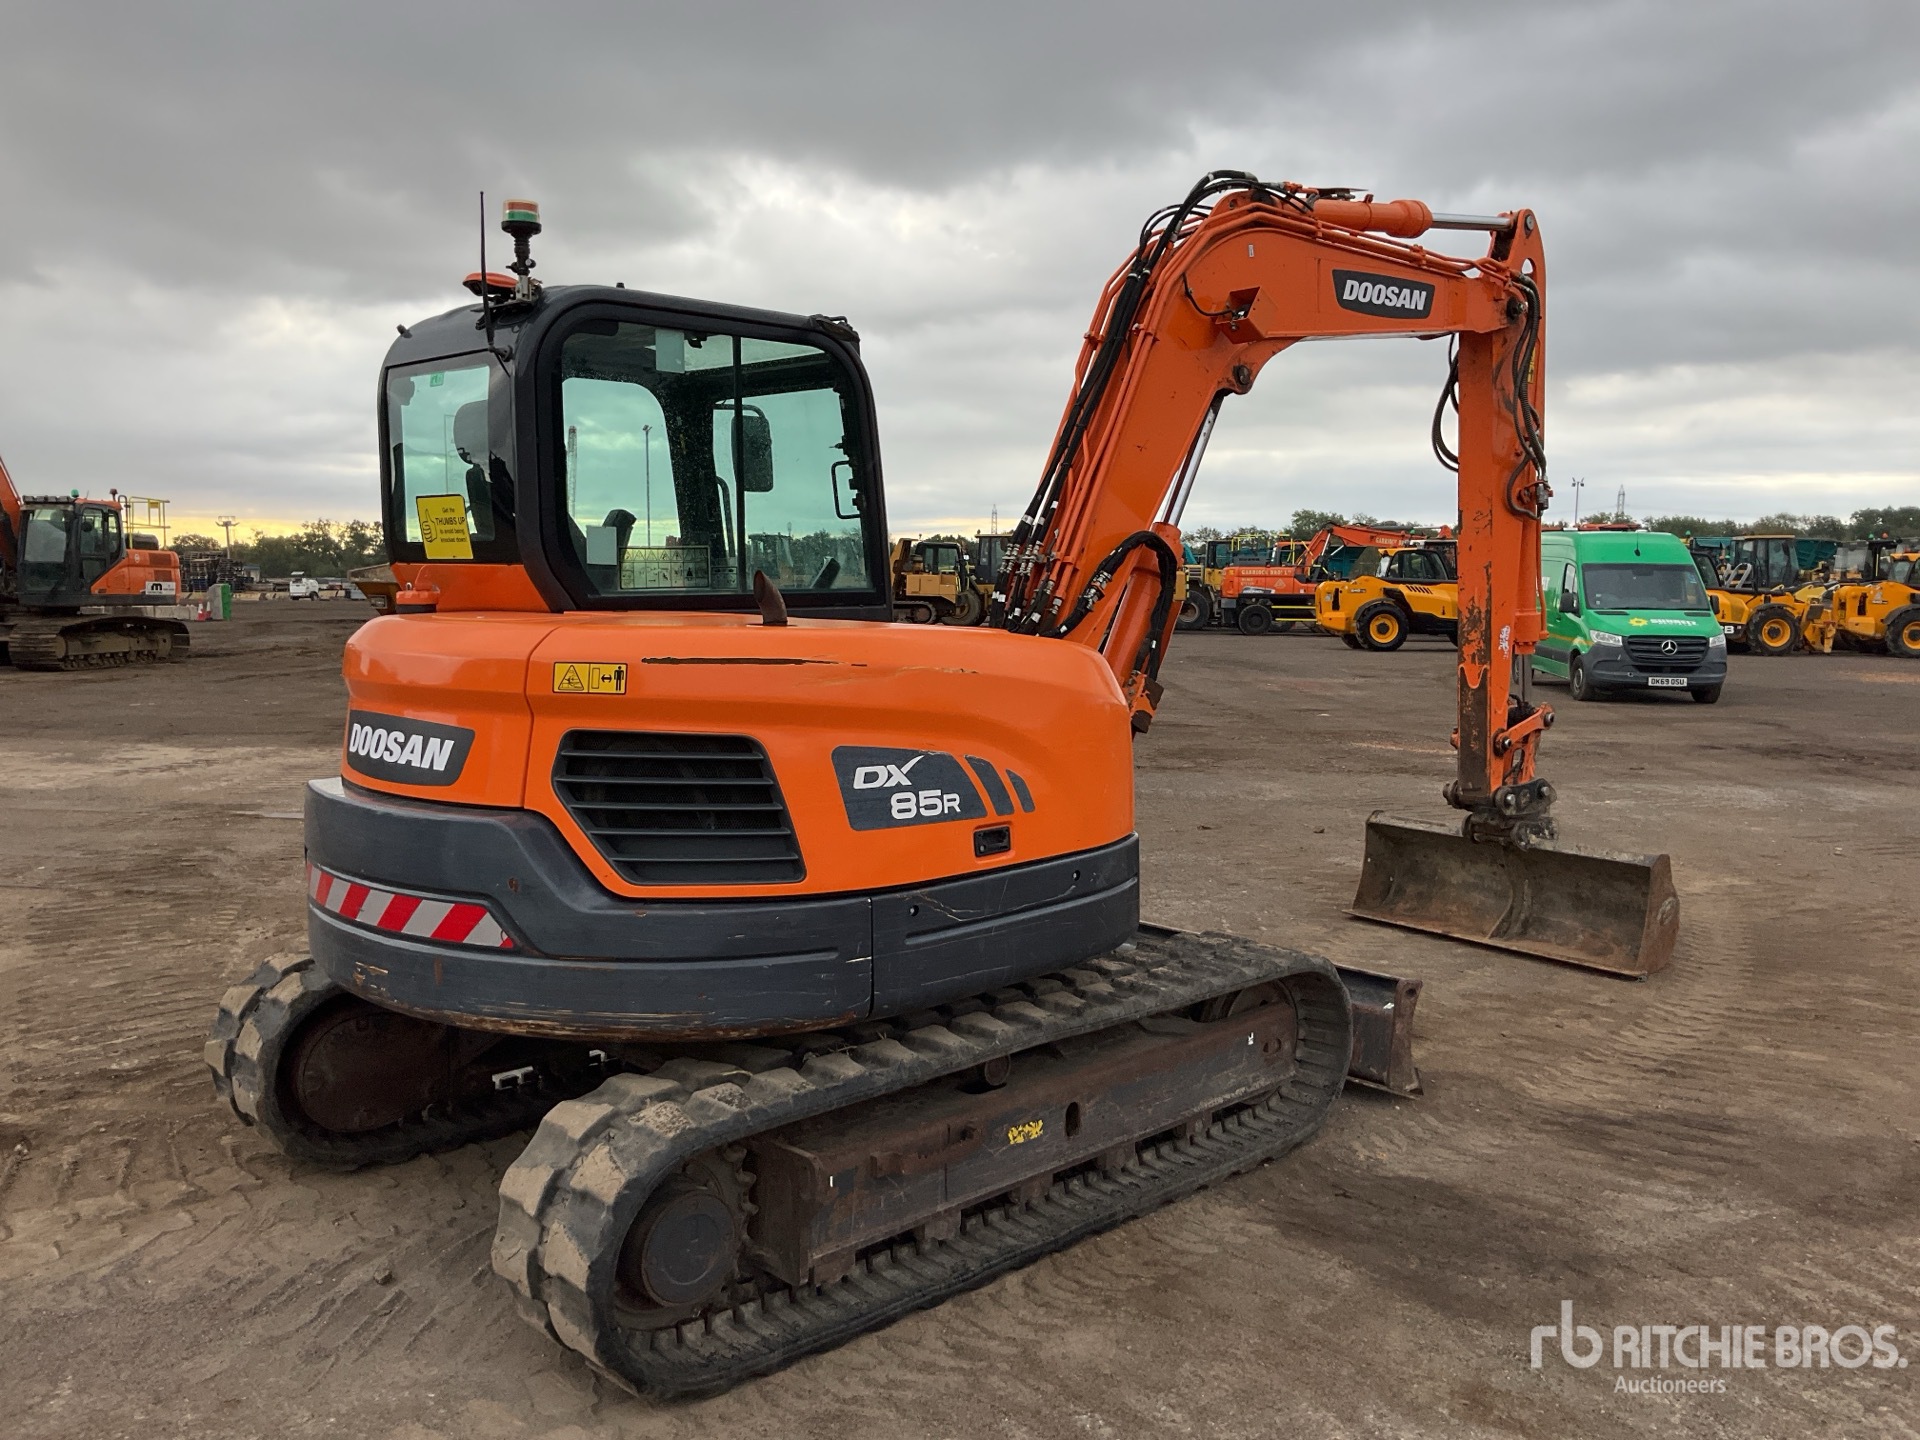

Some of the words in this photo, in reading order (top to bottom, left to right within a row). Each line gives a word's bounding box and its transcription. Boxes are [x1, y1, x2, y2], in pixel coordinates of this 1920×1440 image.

[1343, 280, 1426, 311] DOOSAN
[435, 517, 457, 526] THUMBS
[458, 516, 466, 525] UP
[349, 723, 455, 772] DOOSAN
[853, 755, 925, 789] DX
[891, 790, 961, 820] 85R
